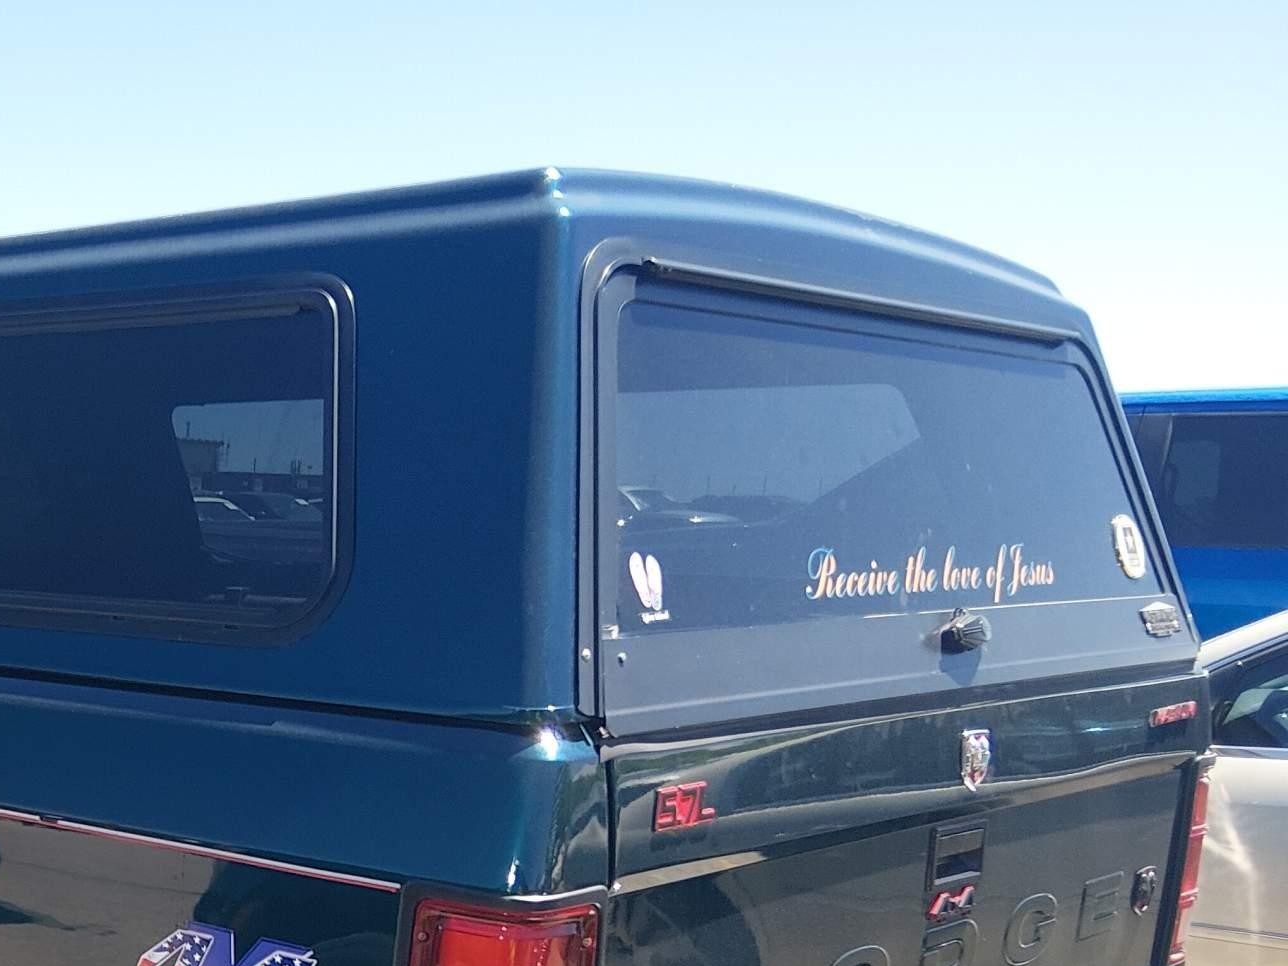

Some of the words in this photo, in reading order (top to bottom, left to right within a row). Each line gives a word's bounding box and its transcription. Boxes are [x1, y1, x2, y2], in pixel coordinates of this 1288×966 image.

[805, 546, 900, 600] Receive
[905, 546, 938, 594] the
[943, 545, 982, 592] love
[986, 544, 1007, 603] of
[1007, 543, 1055, 597] Jesus
